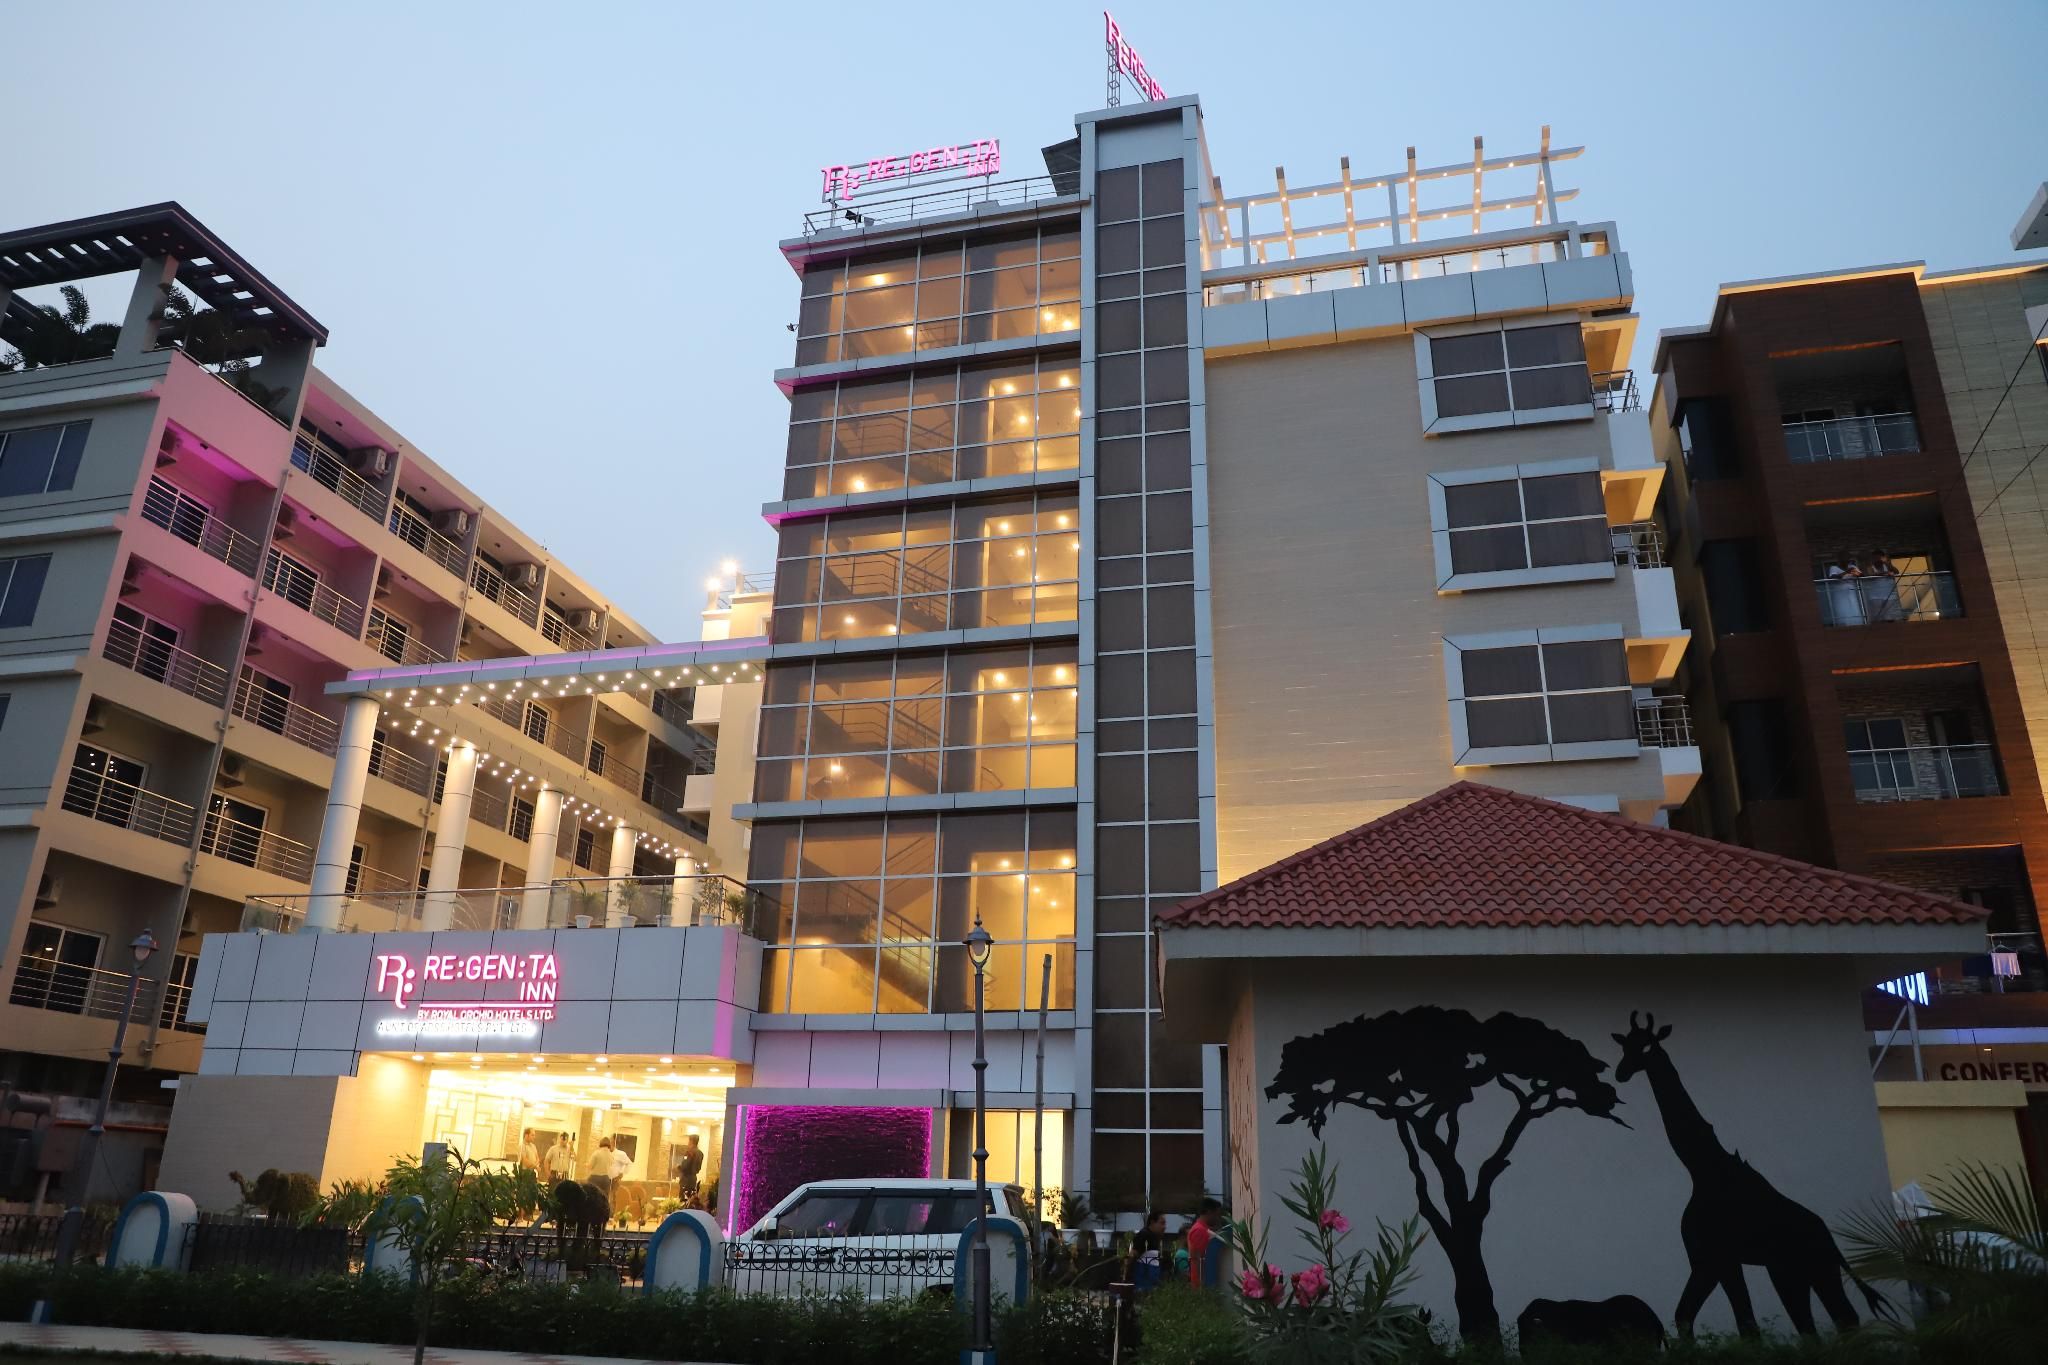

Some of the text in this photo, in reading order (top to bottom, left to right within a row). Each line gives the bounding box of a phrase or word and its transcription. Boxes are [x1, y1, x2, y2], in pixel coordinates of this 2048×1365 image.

[967, 158, 1000, 178] INN
[423, 954, 558, 980] RE:GEN:TA
[519, 981, 557, 1001] INN
[417, 1009, 430, 1020] BY
[431, 1009, 459, 1020] ROYAL
[460, 1009, 494, 1020] ORCHID
[495, 1009, 533, 1020] HOTELS
